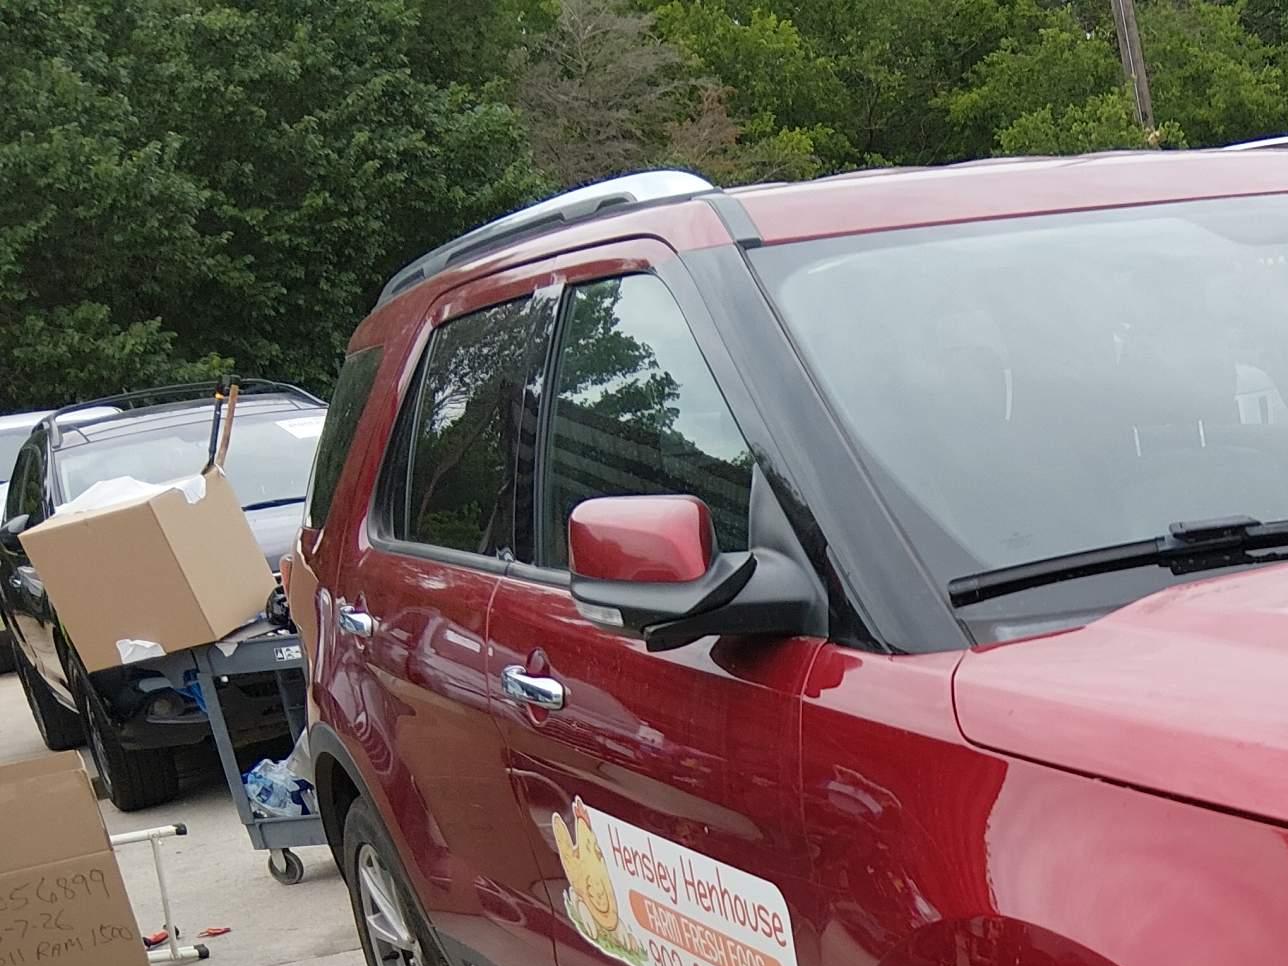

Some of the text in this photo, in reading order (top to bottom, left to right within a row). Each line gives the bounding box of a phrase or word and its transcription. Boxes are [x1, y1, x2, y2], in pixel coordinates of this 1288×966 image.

[608, 823, 787, 947] Hensley Henhouse
[0, 908, 74, 943] -7-26
[644, 898, 684, 946] FARM
[36, 936, 84, 961] RAM
